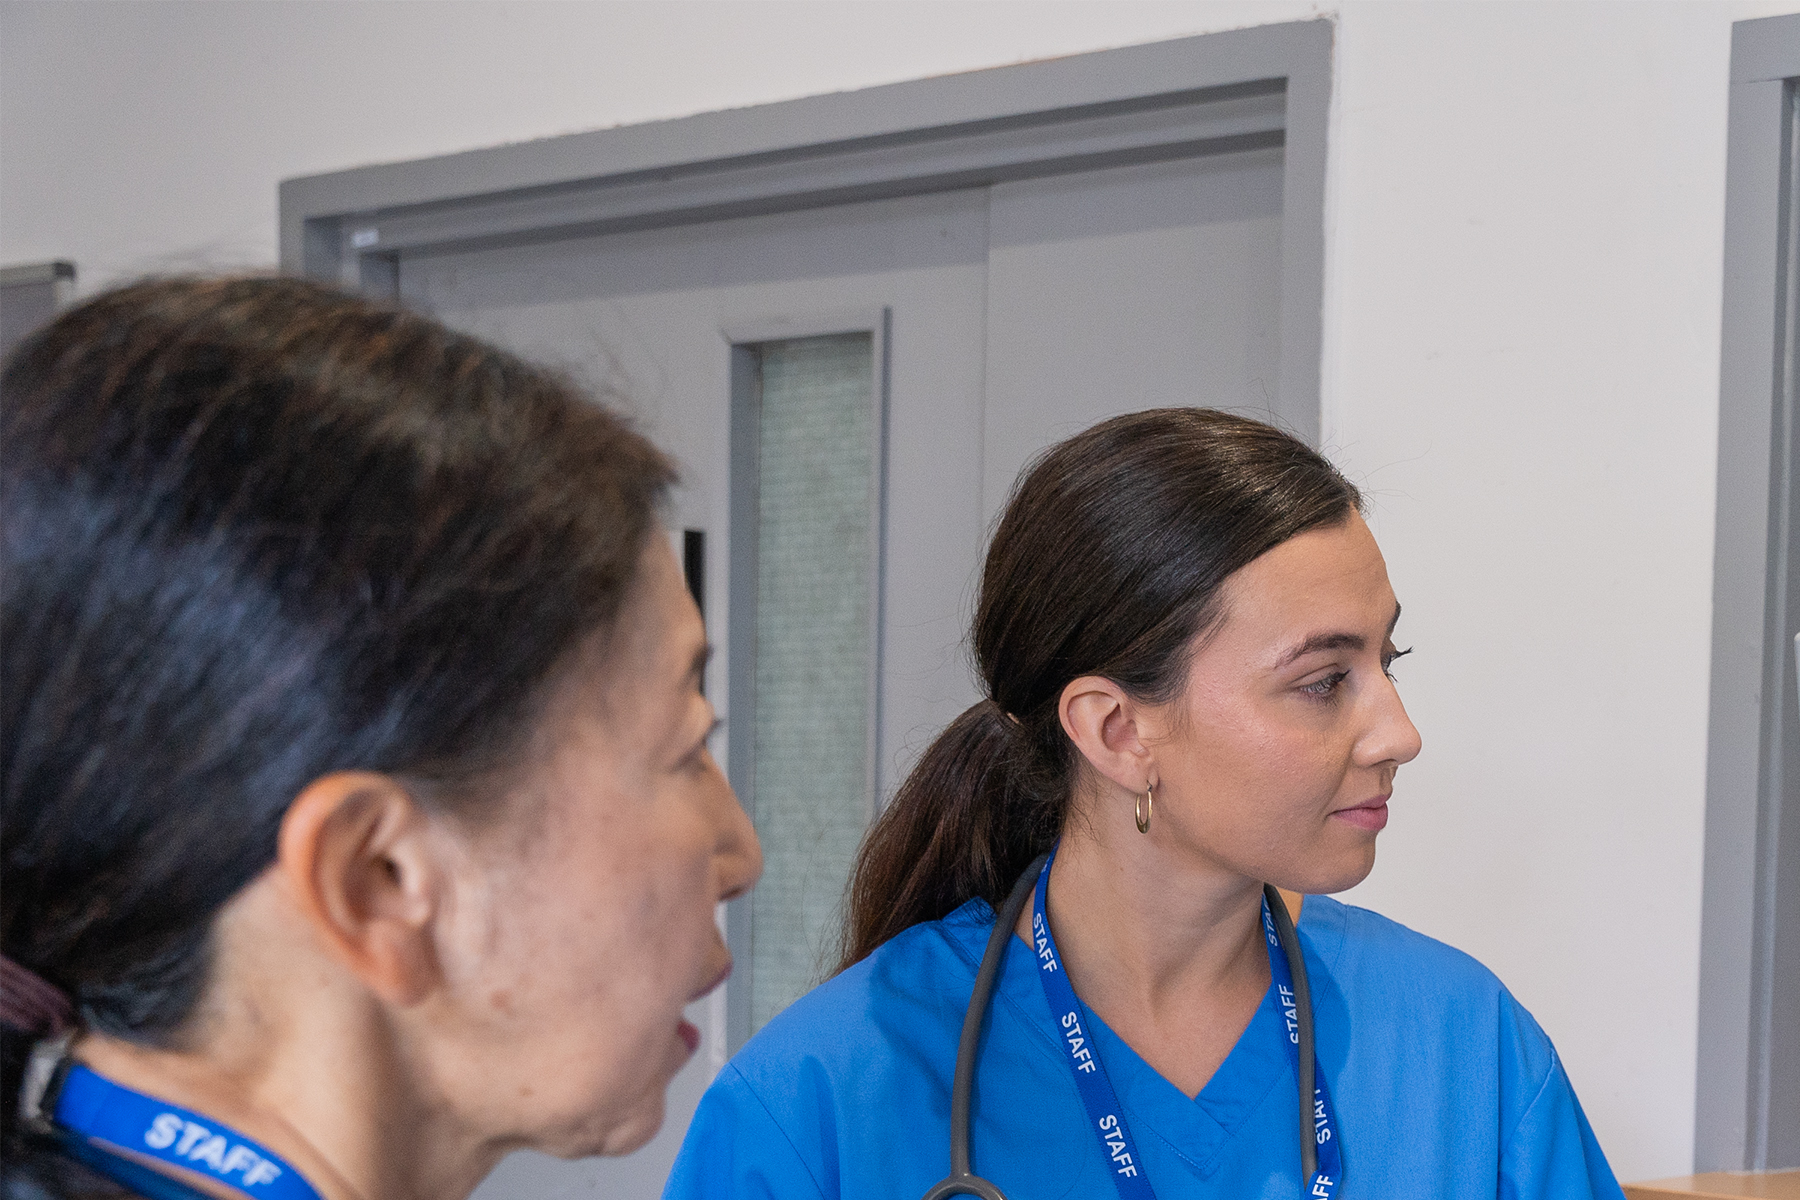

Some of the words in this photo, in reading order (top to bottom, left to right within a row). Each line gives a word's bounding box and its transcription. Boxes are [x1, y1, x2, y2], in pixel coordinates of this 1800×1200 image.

[1033, 912, 1058, 973] STAFF
[1263, 893, 1278, 947] STA
[1061, 1011, 1096, 1074] STAFF
[143, 1112, 282, 1187] STAFF
[1099, 1114, 1138, 1178] STAFF
